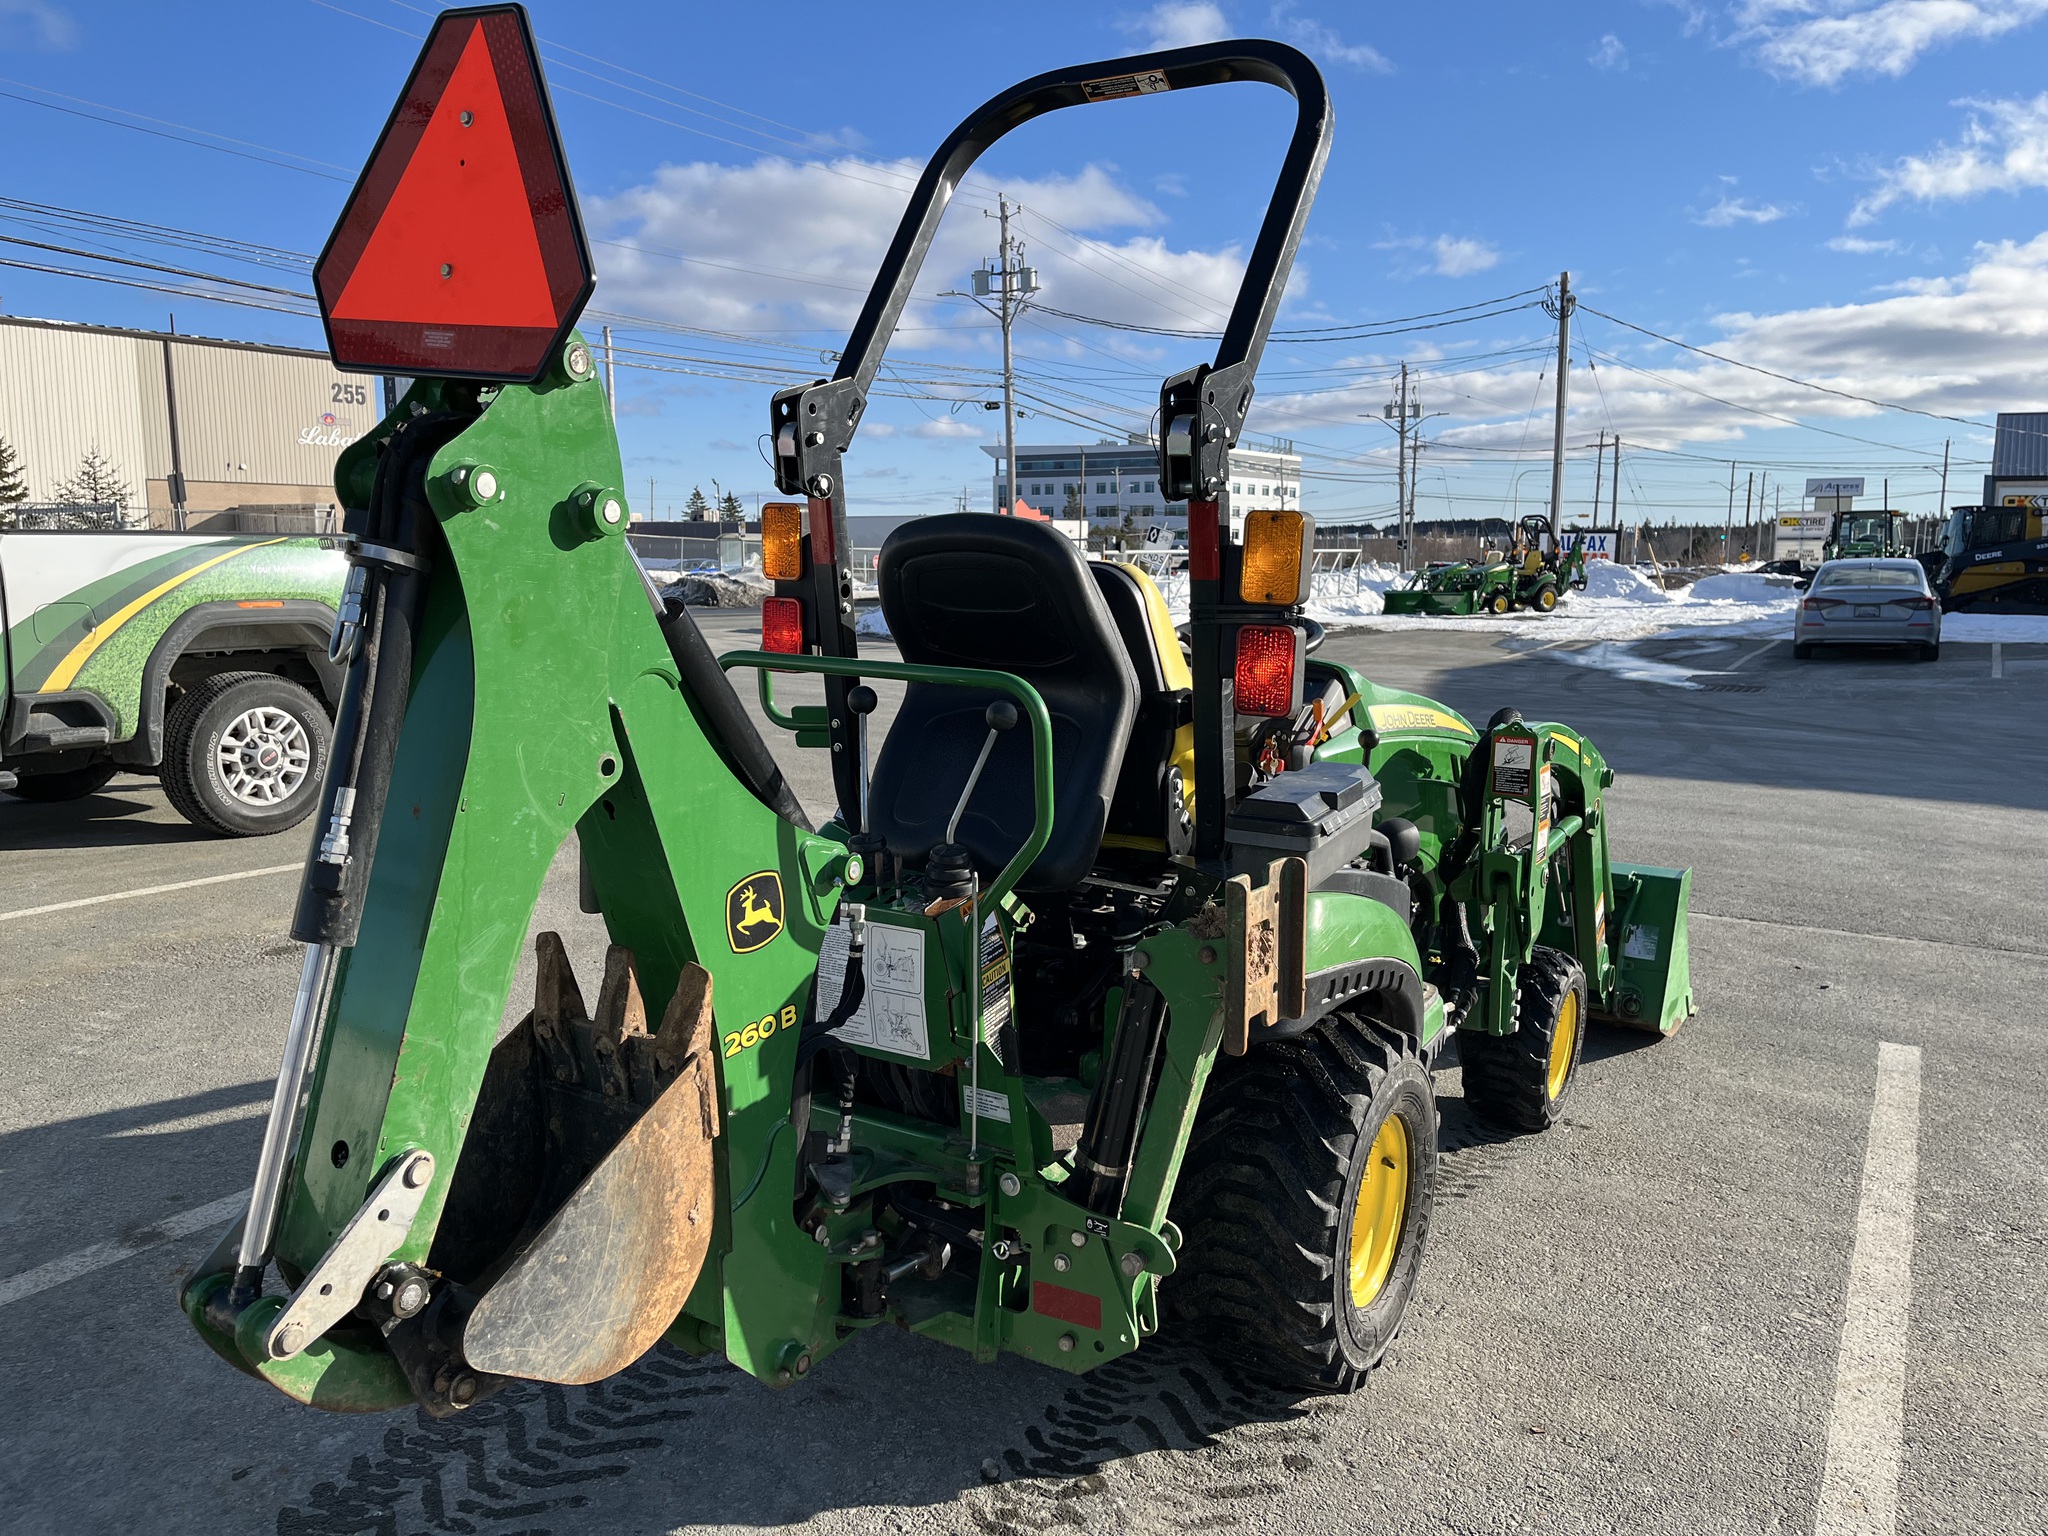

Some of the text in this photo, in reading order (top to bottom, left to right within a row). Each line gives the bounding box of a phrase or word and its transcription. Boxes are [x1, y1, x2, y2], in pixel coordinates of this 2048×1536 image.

[331, 382, 366, 405] 255
[1560, 535, 1607, 551] ALAX
[1143, 553, 1165, 563] ENDS
[1975, 551, 2003, 560] DEERE
[250, 564, 271, 573] Your
[1382, 711, 1436, 727] JOHN DEERE
[302, 710, 326, 782] MICHELIN
[207, 731, 232, 806] MICHELIN
[982, 963, 1007, 987] CAUTION
[723, 1003, 798, 1059] 260 B
